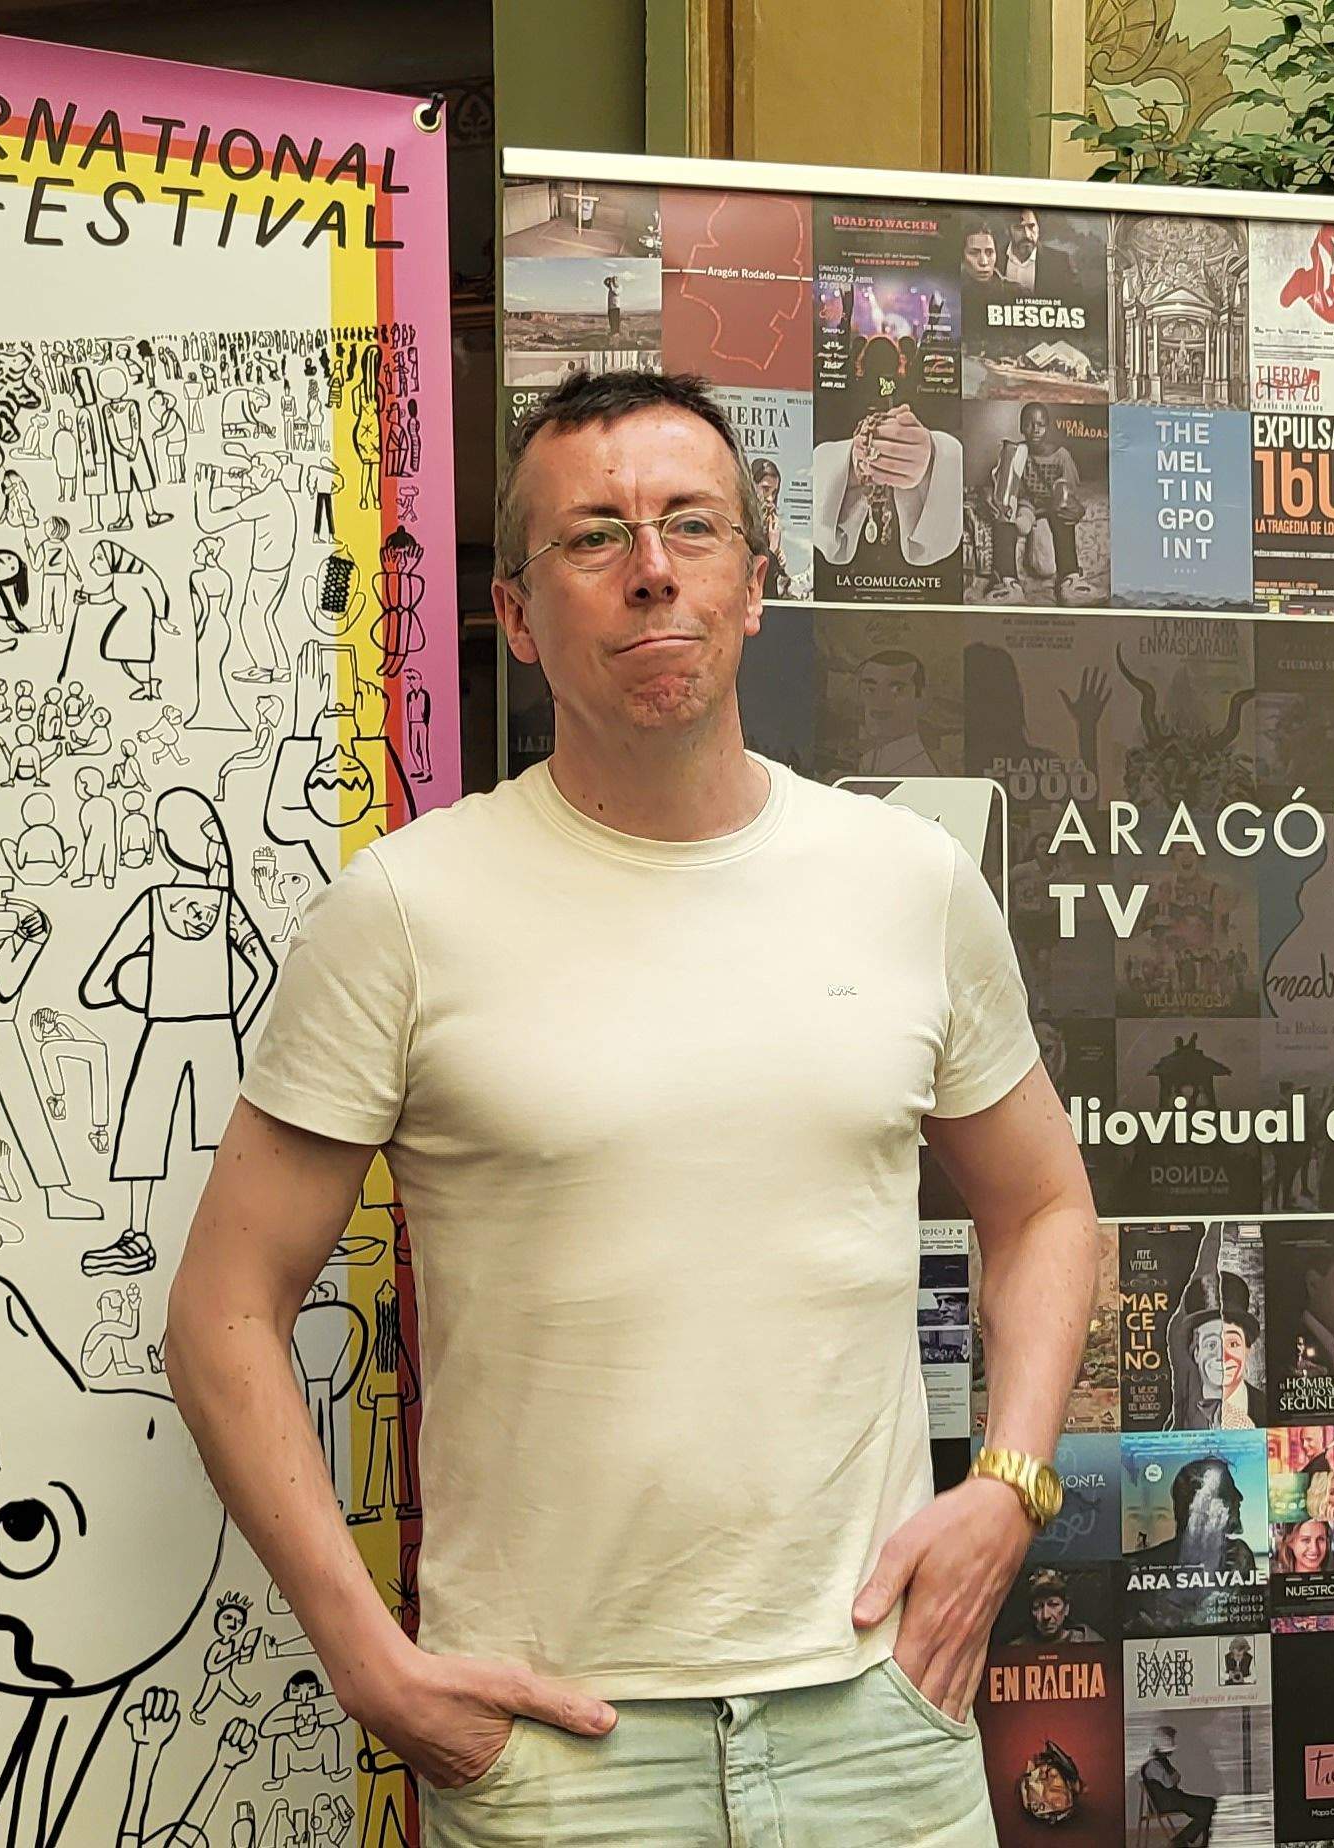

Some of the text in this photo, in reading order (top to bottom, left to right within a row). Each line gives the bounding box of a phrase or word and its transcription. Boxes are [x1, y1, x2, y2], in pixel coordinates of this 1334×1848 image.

[707, 266, 775, 280] Aragón Rodado
[847, 273, 853, 283] 2
[987, 304, 1086, 329] BIESCAS
[1255, 365, 1310, 385] TIERRA
[1056, 419, 1084, 430] VIDAS
[1155, 420, 1210, 445] THE
[1157, 450, 1212, 474] MEL
[1157, 478, 1212, 502] TIN
[1158, 508, 1214, 532] GPO
[1255, 518, 1266, 533] LA
[1267, 519, 1309, 534] TRAGEDIA
[1310, 521, 1322, 535] DE
[1162, 536, 1212, 560] INT
[836, 575, 941, 588] LA COMULGANTE
[992, 757, 1086, 774] PLANETA
[1048, 884, 1150, 939] TV
[1142, 992, 1232, 1009] VILLAVICIOSA
[1150, 1165, 1229, 1185] RONDA
[1119, 1293, 1168, 1312] MAR
[1126, 1313, 1156, 1331] CE
[1130, 1331, 1151, 1350] LI
[1125, 1352, 1160, 1370] NO
[1295, 1387, 1326, 1398] QUISO
[1176, 1569, 1268, 1590] SALVAJE
[990, 1666, 1020, 1702] EN
[1025, 1663, 1106, 1701] RACHA
